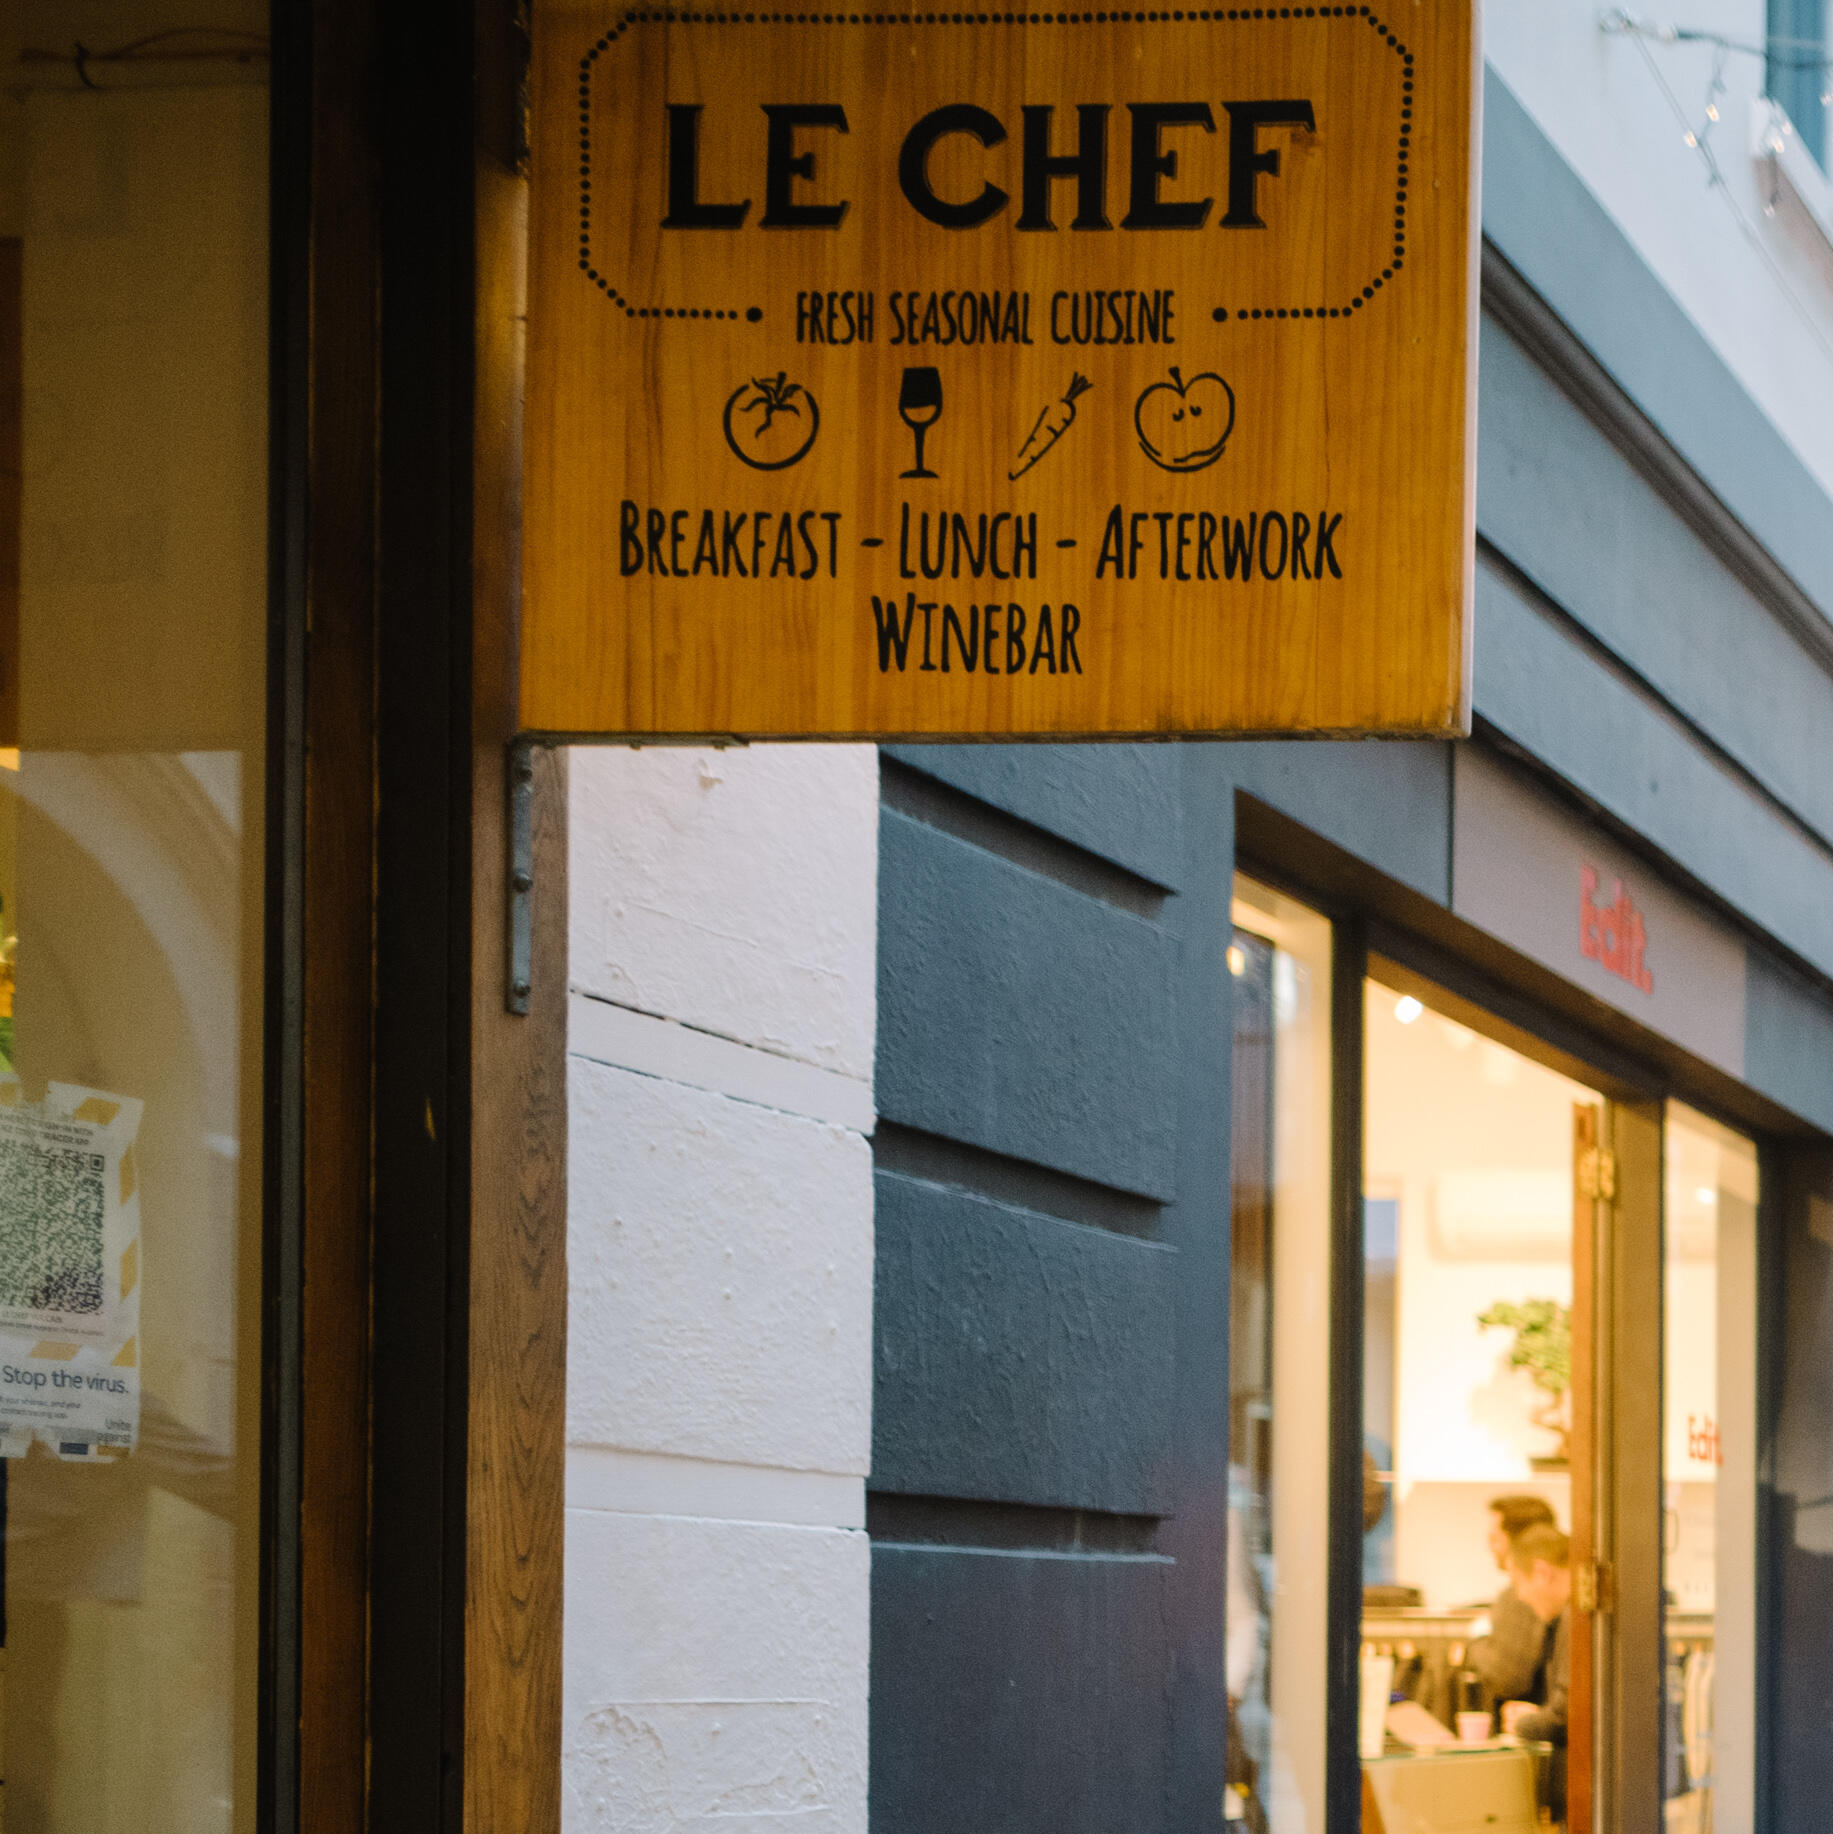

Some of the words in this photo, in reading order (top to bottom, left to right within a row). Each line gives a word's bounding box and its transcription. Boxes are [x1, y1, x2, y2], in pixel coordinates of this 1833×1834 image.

[660, 102, 852, 231] LE
[898, 98, 1316, 232] CHEF
[796, 290, 874, 346] FRESH
[888, 290, 1034, 346] SEASONAL
[1050, 290, 1177, 346] CUISINE
[619, 500, 843, 580] BREAKFAST
[899, 501, 1037, 580] LUNCH
[1095, 503, 1344, 582] AFTERWORK
[870, 592, 1083, 675] WINEBAR
[2, 1365, 47, 1390] Stop
[51, 1367, 83, 1389] the
[87, 1372, 130, 1393] virus.
